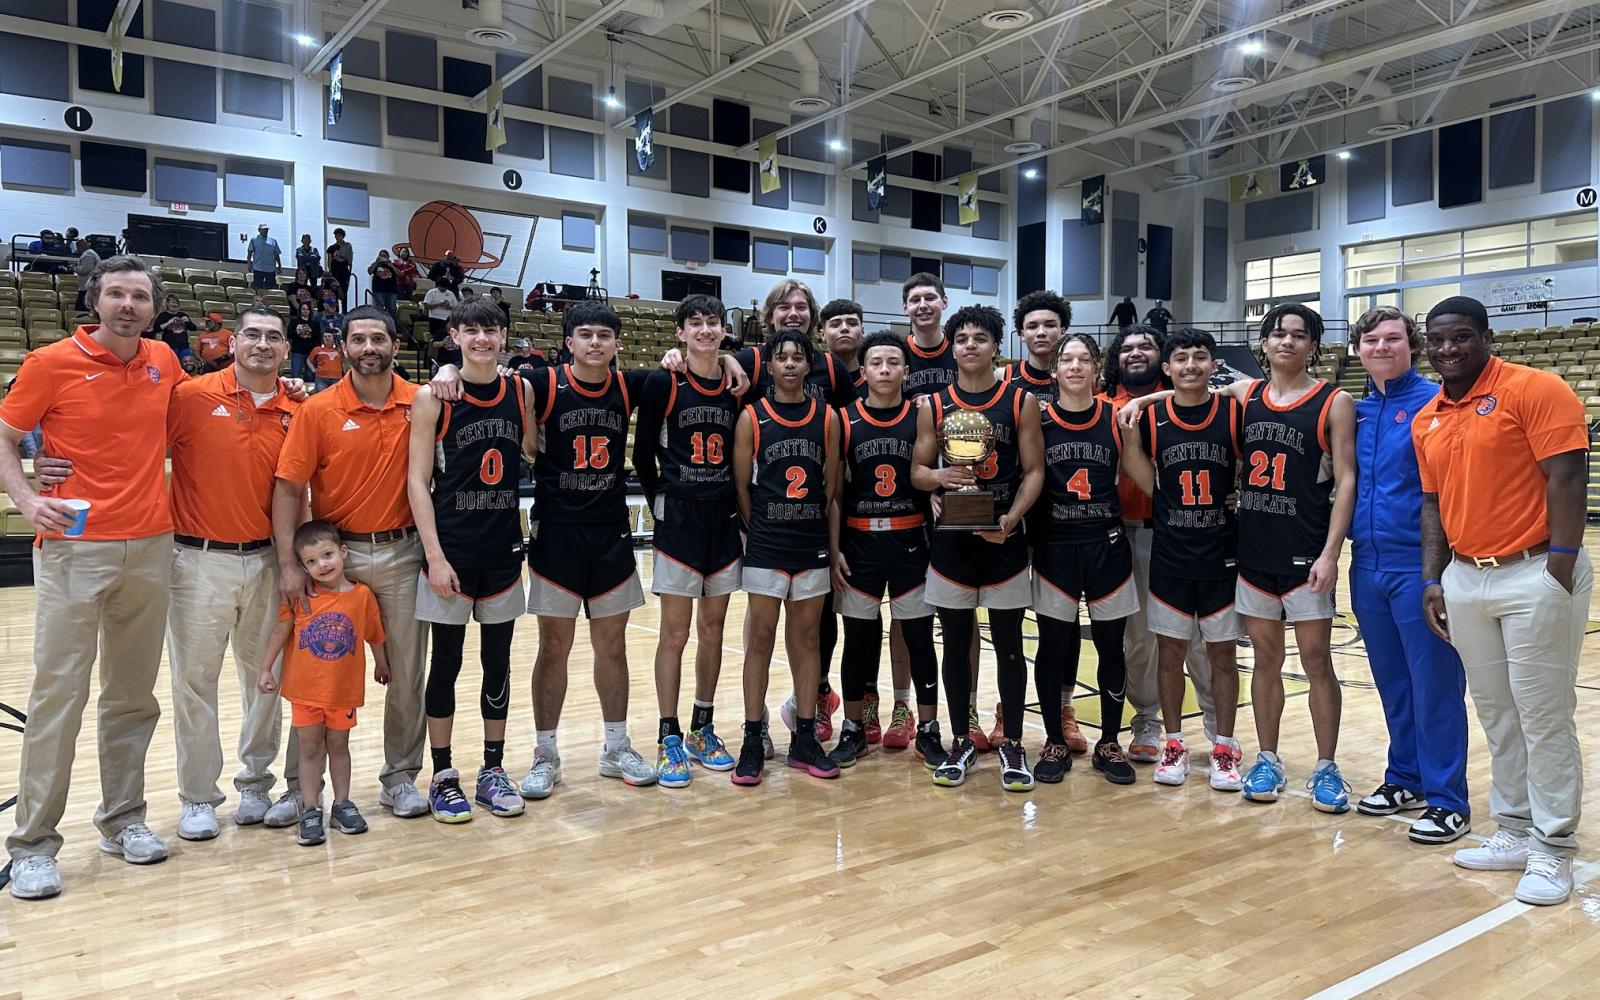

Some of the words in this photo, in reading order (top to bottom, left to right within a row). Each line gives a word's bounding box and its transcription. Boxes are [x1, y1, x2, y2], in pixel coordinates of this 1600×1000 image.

[508, 173, 516, 187] J
[1580, 190, 1593, 205] M
[816, 219, 825, 232] K
[1139, 239, 1145, 251] L
[559, 407, 623, 433] CENTRAL
[573, 435, 610, 469] 15
[691, 431, 723, 464] 10
[764, 438, 822, 465] CENTRAL
[1045, 441, 1111, 467] CENTRAL
[1161, 441, 1229, 468] CENTRAL
[480, 447, 504, 485] 0
[1248, 450, 1287, 491] 21
[785, 465, 808, 499] 2
[874, 464, 897, 497] 3
[1066, 468, 1092, 500] 4
[1179, 469, 1213, 505] 11
[455, 489, 517, 510] BOBCATS
